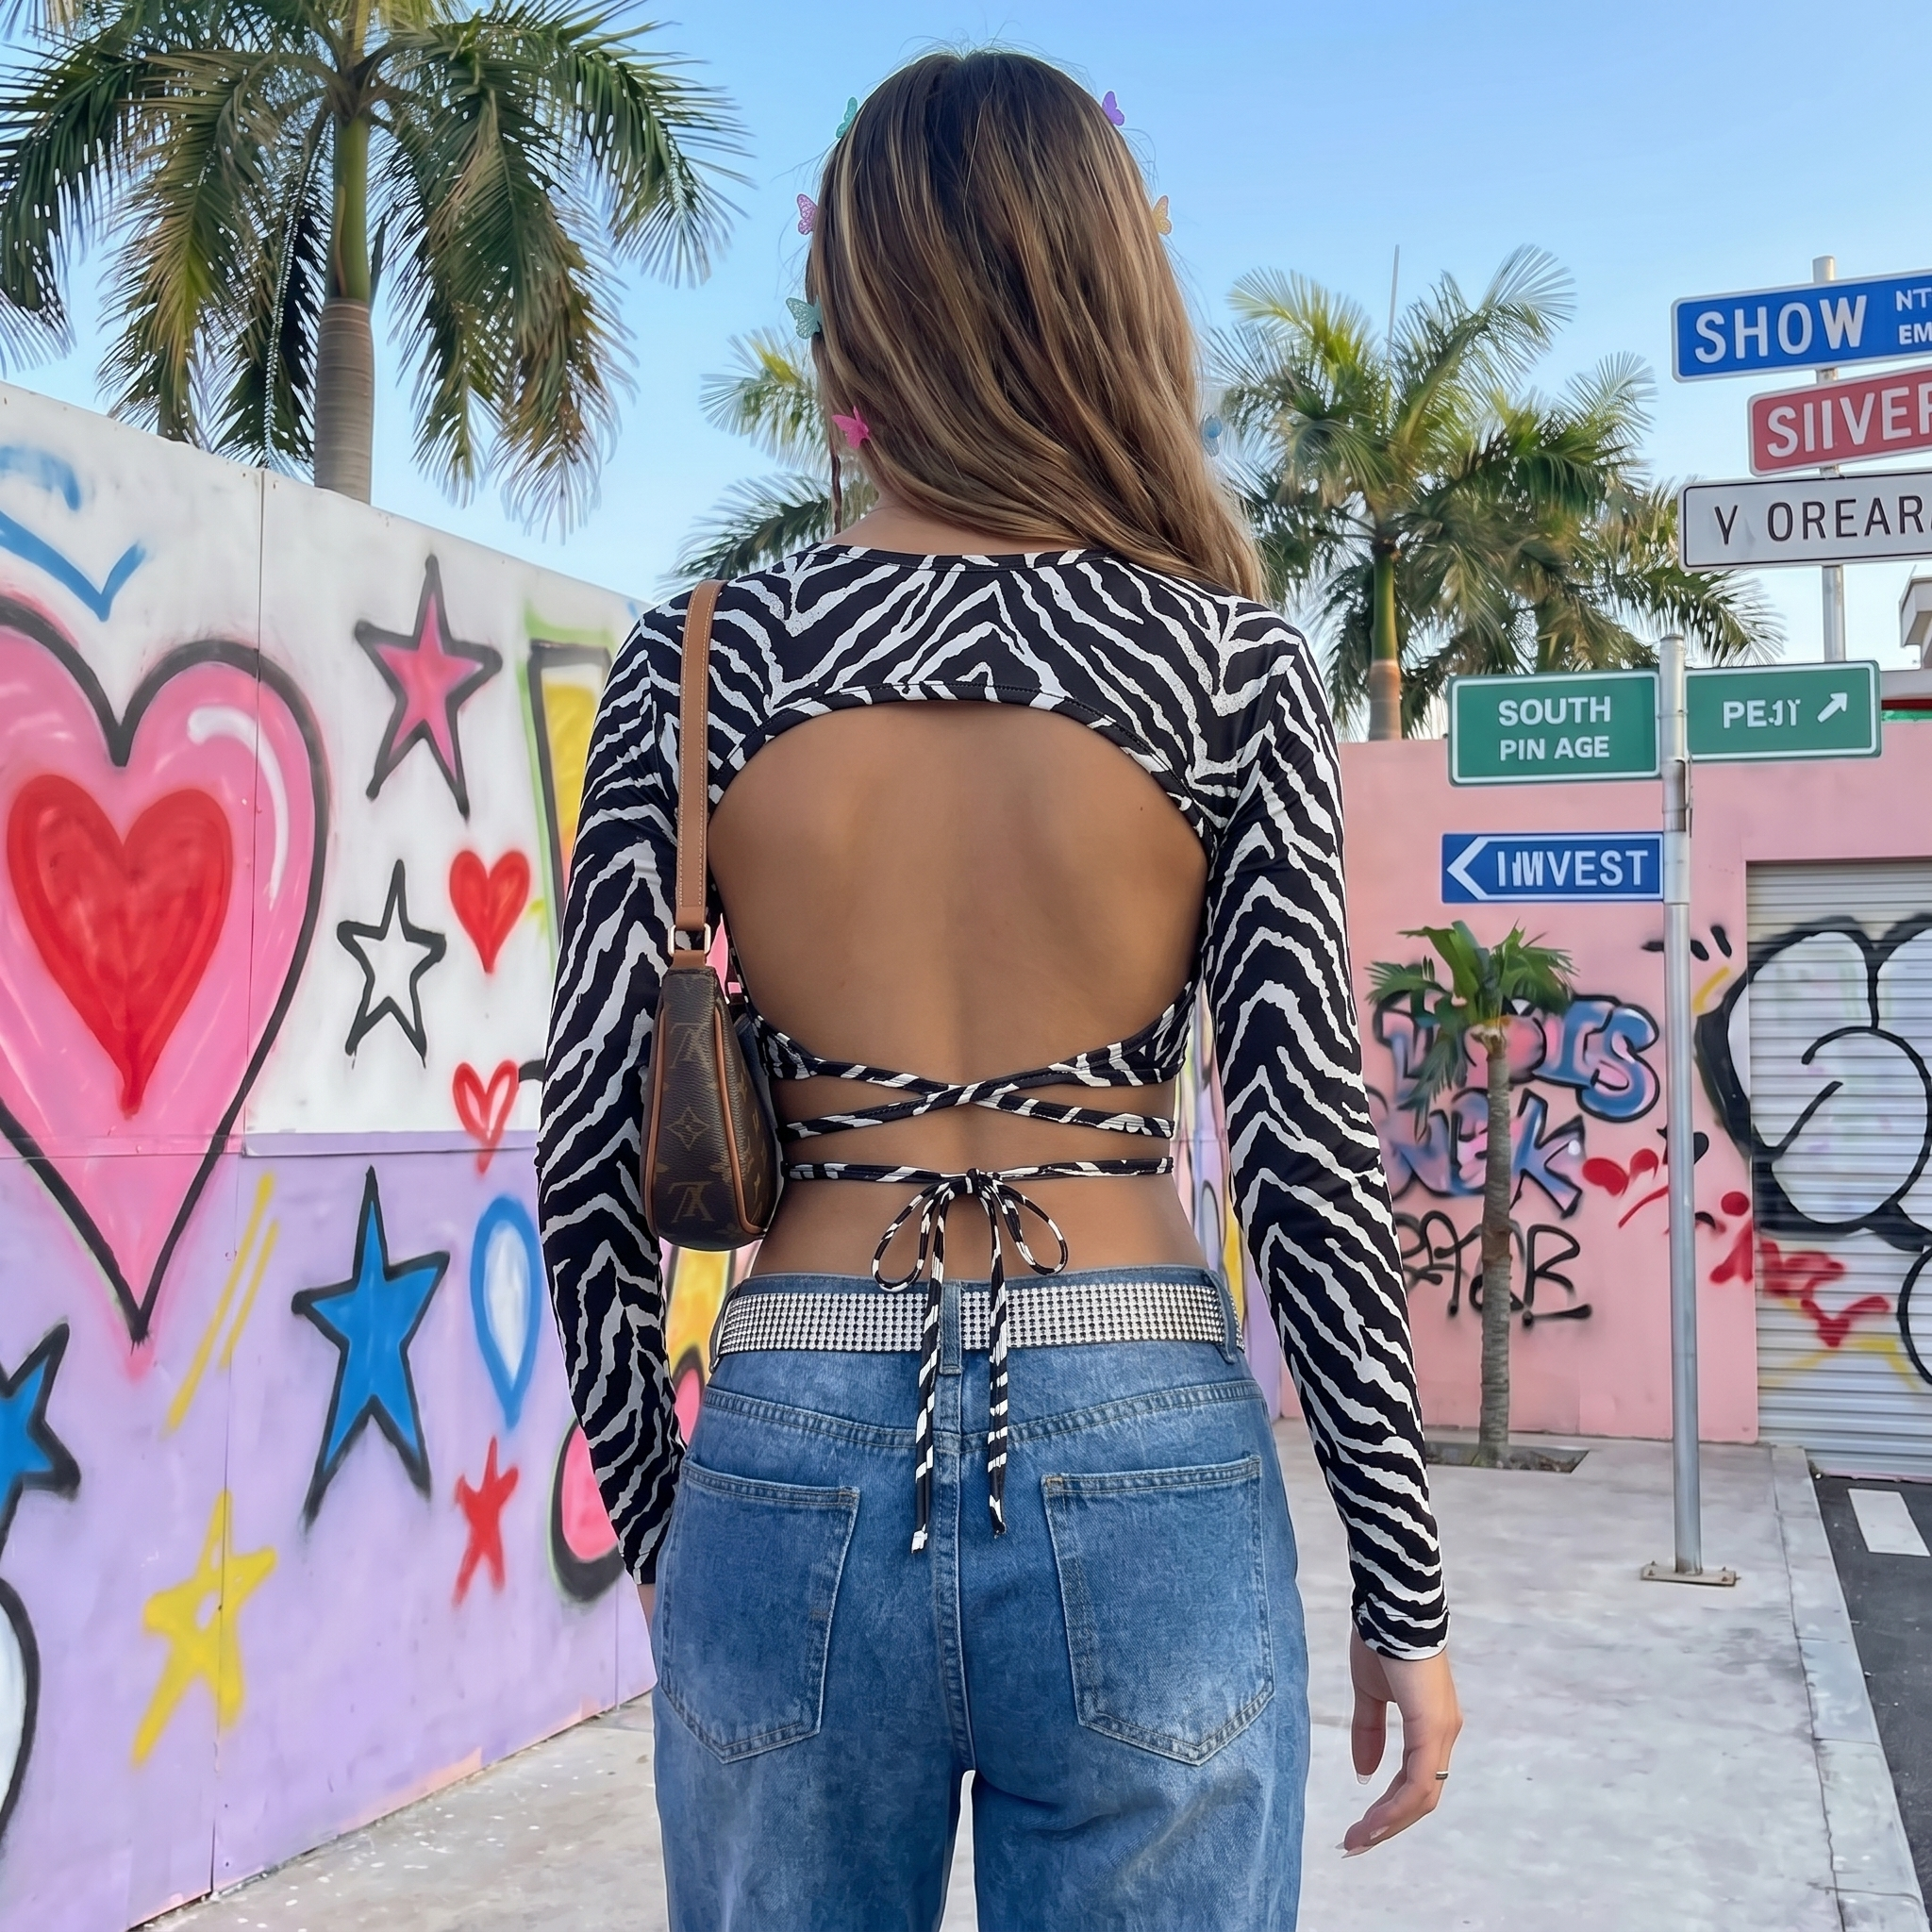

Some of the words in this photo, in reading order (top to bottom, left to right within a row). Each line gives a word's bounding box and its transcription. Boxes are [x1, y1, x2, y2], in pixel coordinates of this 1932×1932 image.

[1694, 294, 1868, 364] SHOW
[1767, 494, 1932, 542] OREAR
[1498, 695, 1611, 727] SOUTH
[1500, 738, 1545, 761] PIN
[1554, 736, 1610, 759] AGE
